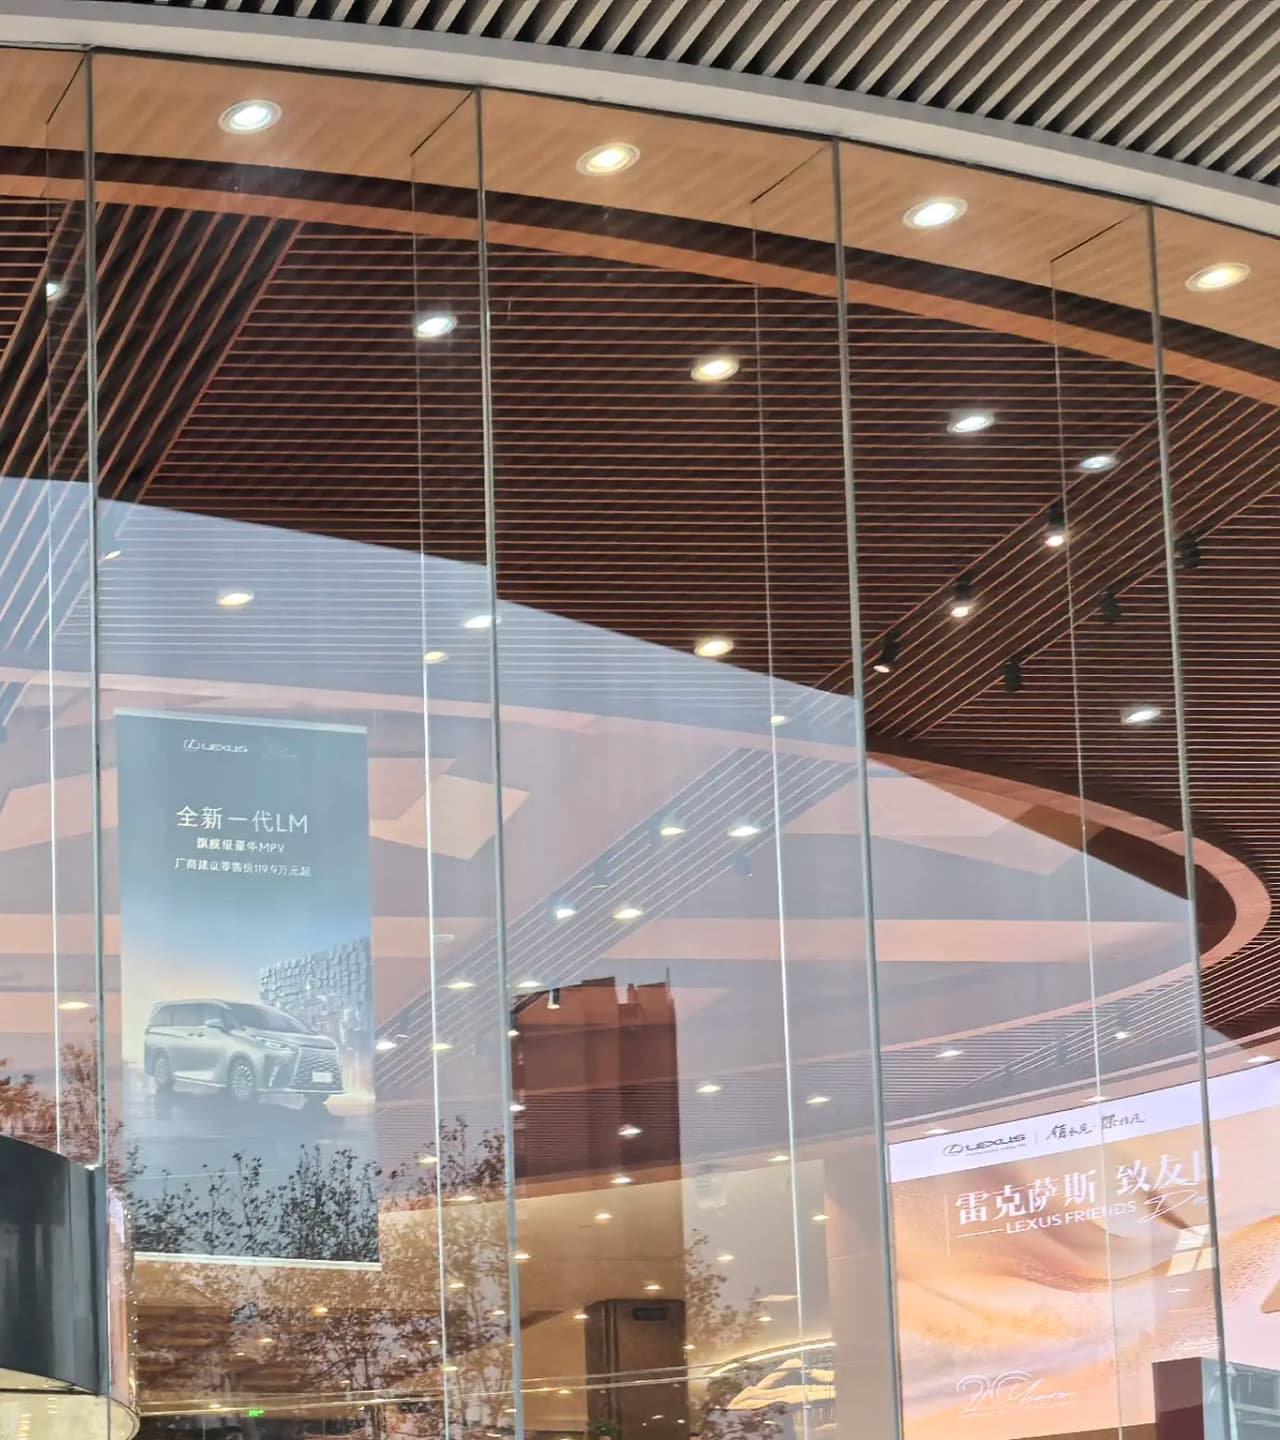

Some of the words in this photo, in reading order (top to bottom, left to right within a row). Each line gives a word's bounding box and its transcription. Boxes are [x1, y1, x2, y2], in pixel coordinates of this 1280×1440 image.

[176, 805, 308, 834] 全新一代LM
[965, 1133, 1026, 1151] LEXUS
[955, 1169, 1097, 1225] 雷克萨斯
[1006, 1213, 1063, 1235] LEXUS
[1064, 1200, 1137, 1226] FRIENDS
